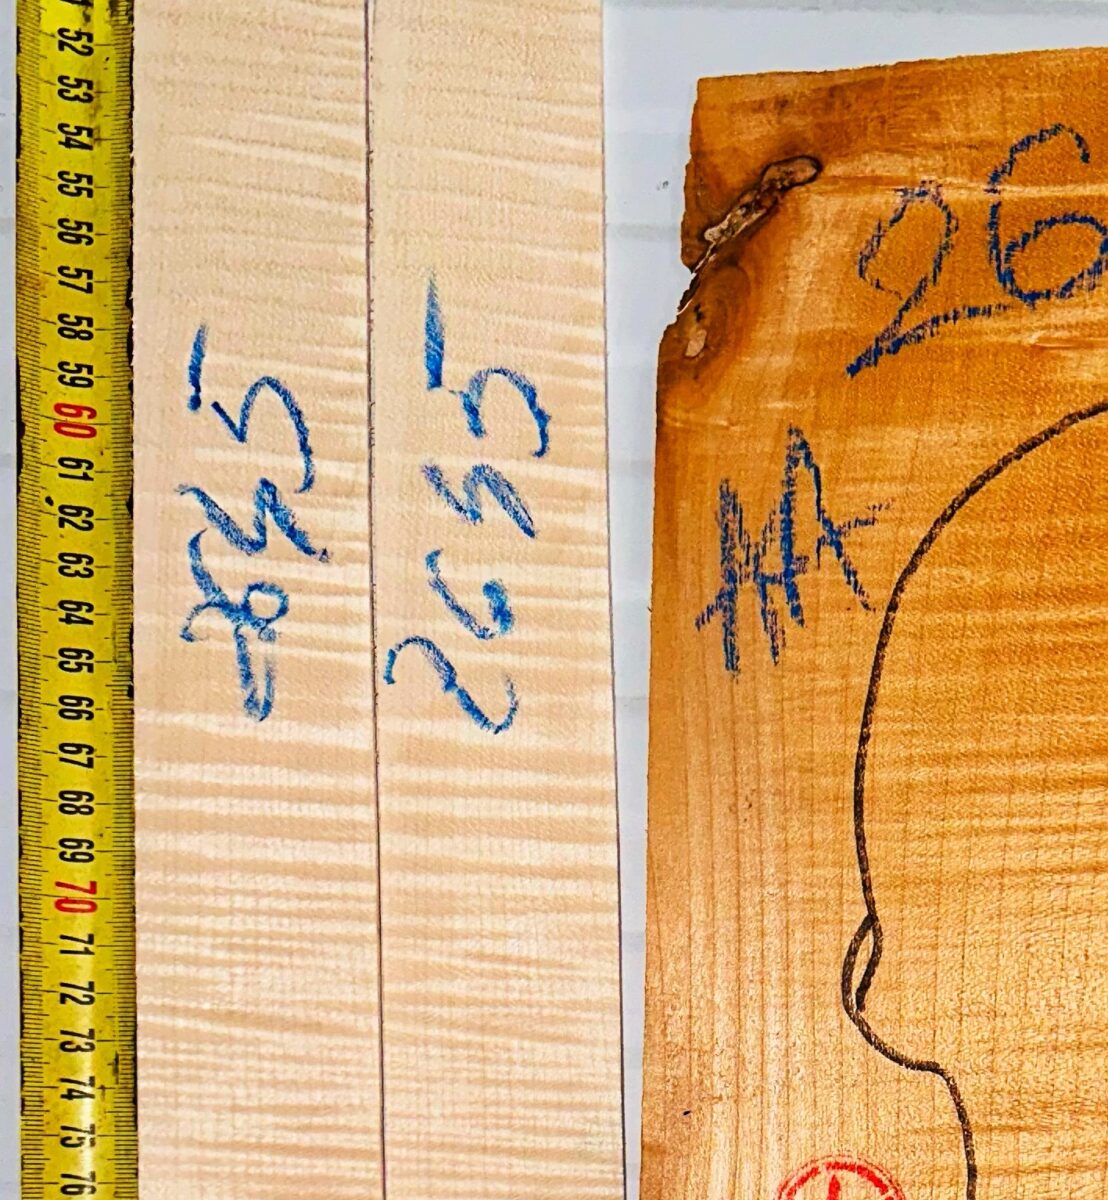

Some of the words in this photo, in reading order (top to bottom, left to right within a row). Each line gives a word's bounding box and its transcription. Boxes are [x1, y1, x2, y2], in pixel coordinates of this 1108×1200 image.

[57, 26, 94, 57] 52
[57, 75, 94, 104] 53
[57, 122, 94, 151] 54
[57, 170, 94, 199] 55
[57, 217, 94, 246] 56
[57, 265, 94, 294] 57
[57, 313, 94, 341] 58
[57, 360, 94, 389] 59
[52, 402, 98, 439] 60
[57, 456, 94, 482] 61
[383, 268, 551, 735] 2645
[58, 504, 94, 532] 62
[58, 552, 94, 579] 63
[58, 599, 94, 626] 64
[58, 647, 95, 674] 65
[58, 695, 95, 721] 66
[58, 742, 95, 769] 67
[58, 790, 95, 816] 68
[59, 837, 95, 863] 69
[54, 880, 99, 913] 70
[59, 933, 95, 957] 71
[59, 981, 95, 1005] 72
[59, 1028, 96, 1053] 73
[60, 1076, 96, 1101] 74
[60, 1124, 96, 1148] 75
[60, 1172, 97, 1196] 76
